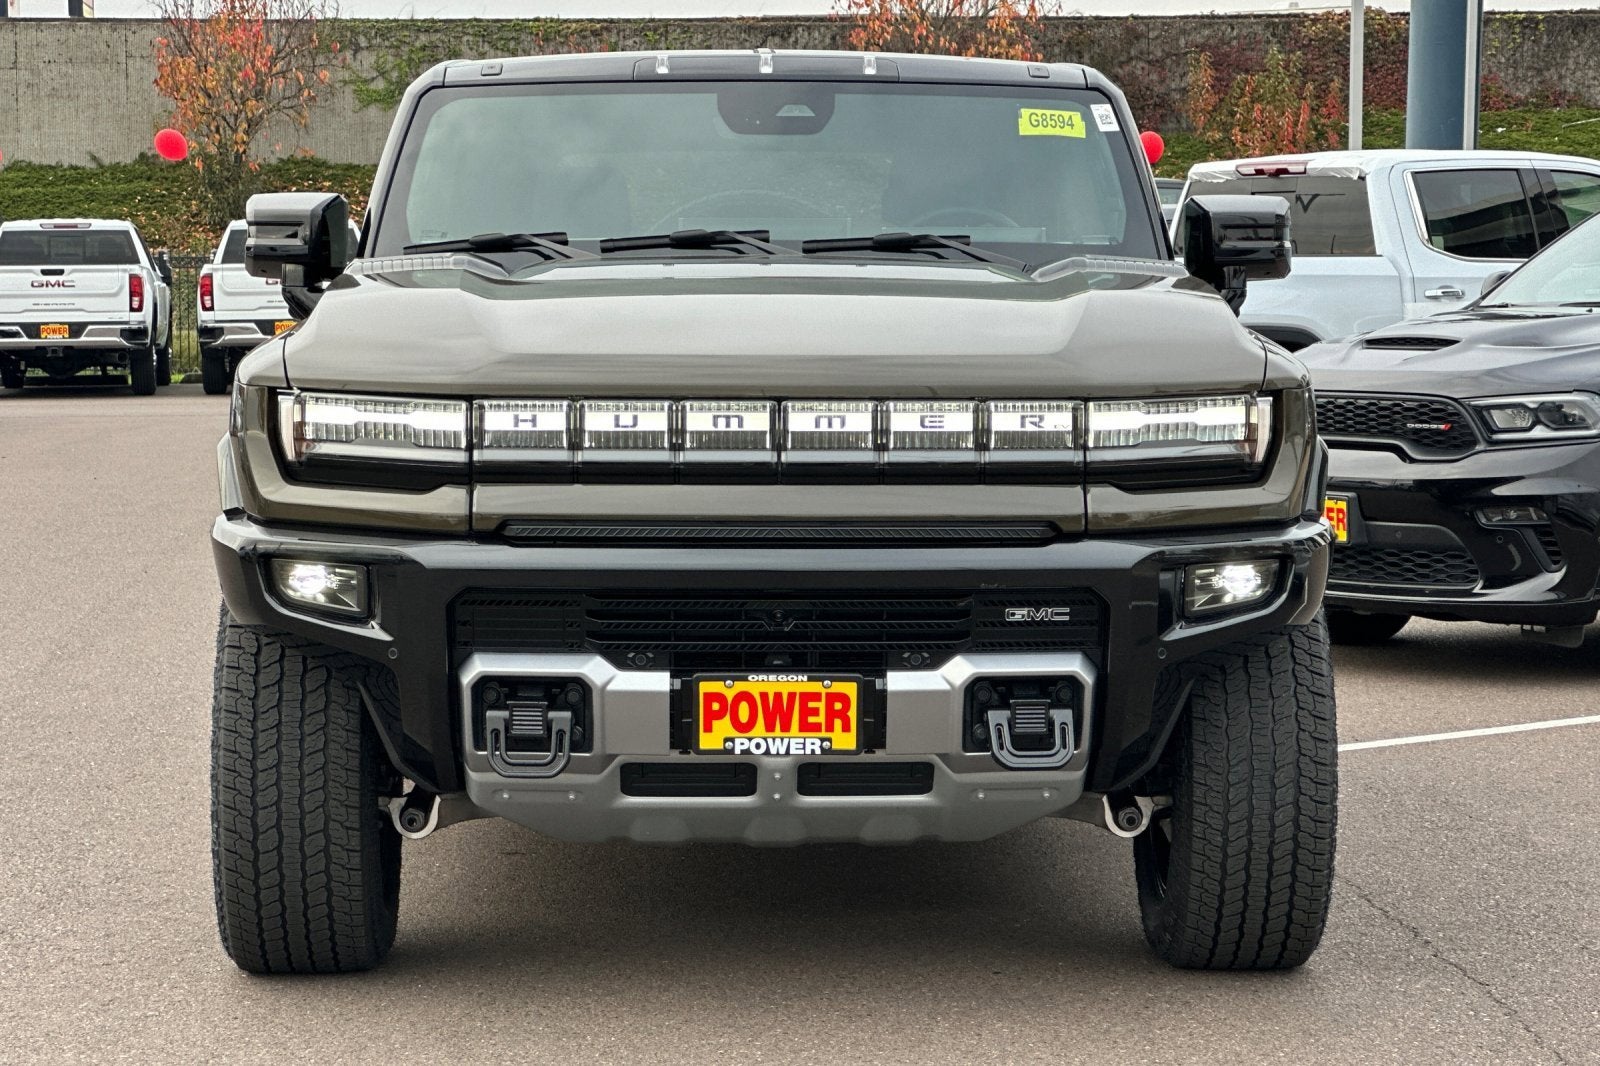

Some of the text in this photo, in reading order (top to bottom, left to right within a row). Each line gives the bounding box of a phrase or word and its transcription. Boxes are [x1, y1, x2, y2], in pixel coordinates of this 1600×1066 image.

[1028, 112, 1074, 130] G8594
[30, 280, 75, 288] GMC
[41, 327, 68, 336] POWER
[513, 414, 1045, 429] HUMMER
[1005, 607, 1070, 621] GMC
[703, 691, 851, 733] POWER
[734, 738, 822, 755] POWER
